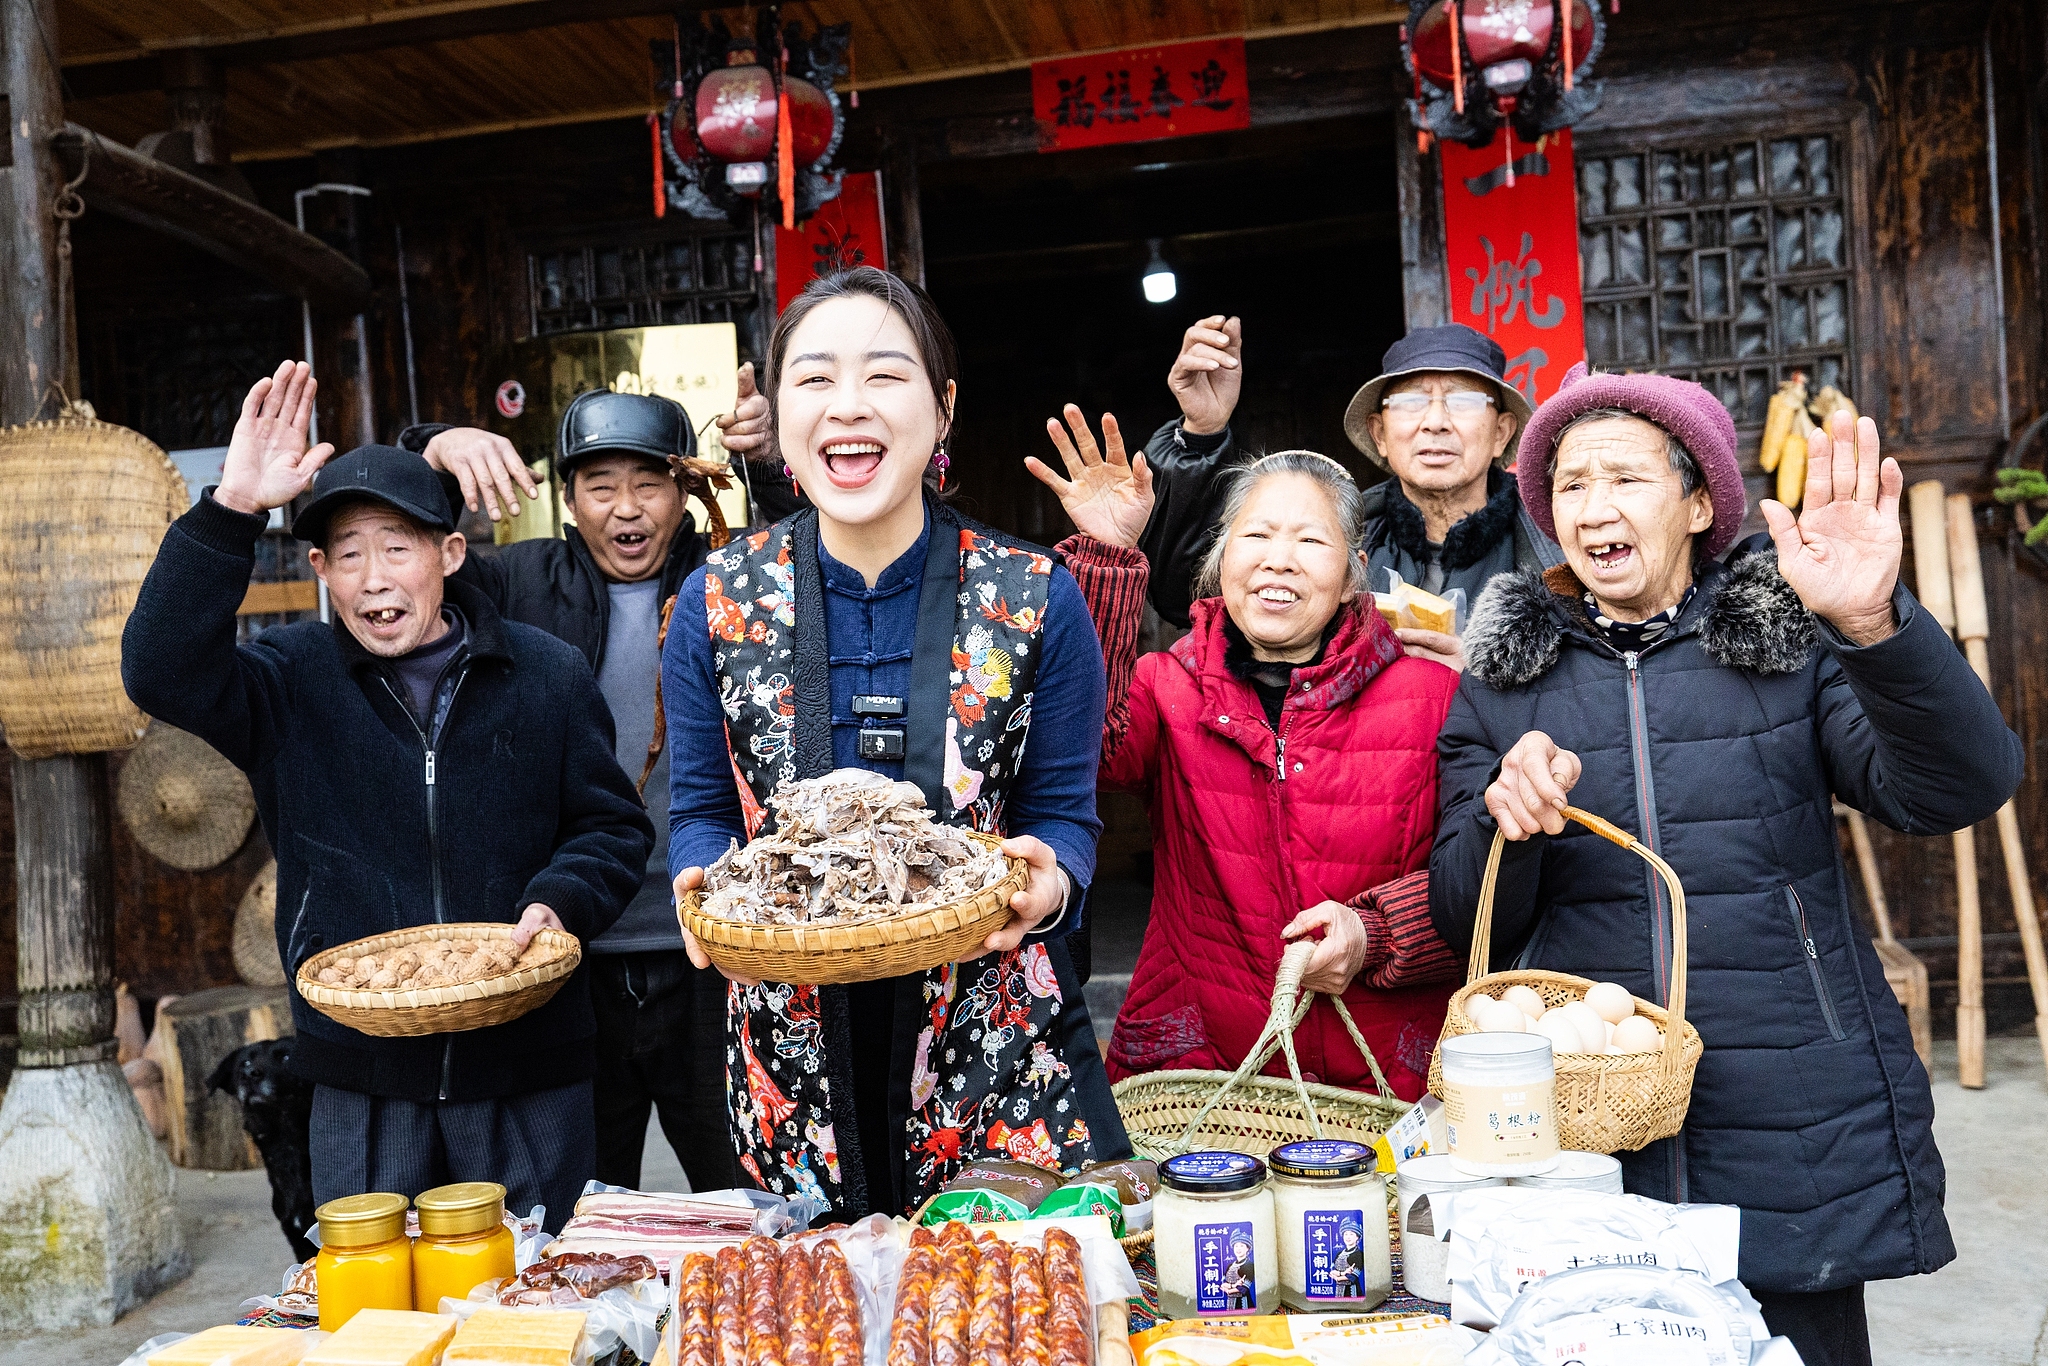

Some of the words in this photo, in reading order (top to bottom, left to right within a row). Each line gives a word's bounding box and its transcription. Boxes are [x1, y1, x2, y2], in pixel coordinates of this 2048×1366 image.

[1489, 1111, 1541, 1130] 葛根粉
[1311, 1227, 1329, 1283] 手工制作
[1567, 1251, 1657, 1269] 土家扣肉
[1202, 1240, 1220, 1297] 手工制作
[1608, 1318, 1708, 1342] 土家扣肉
